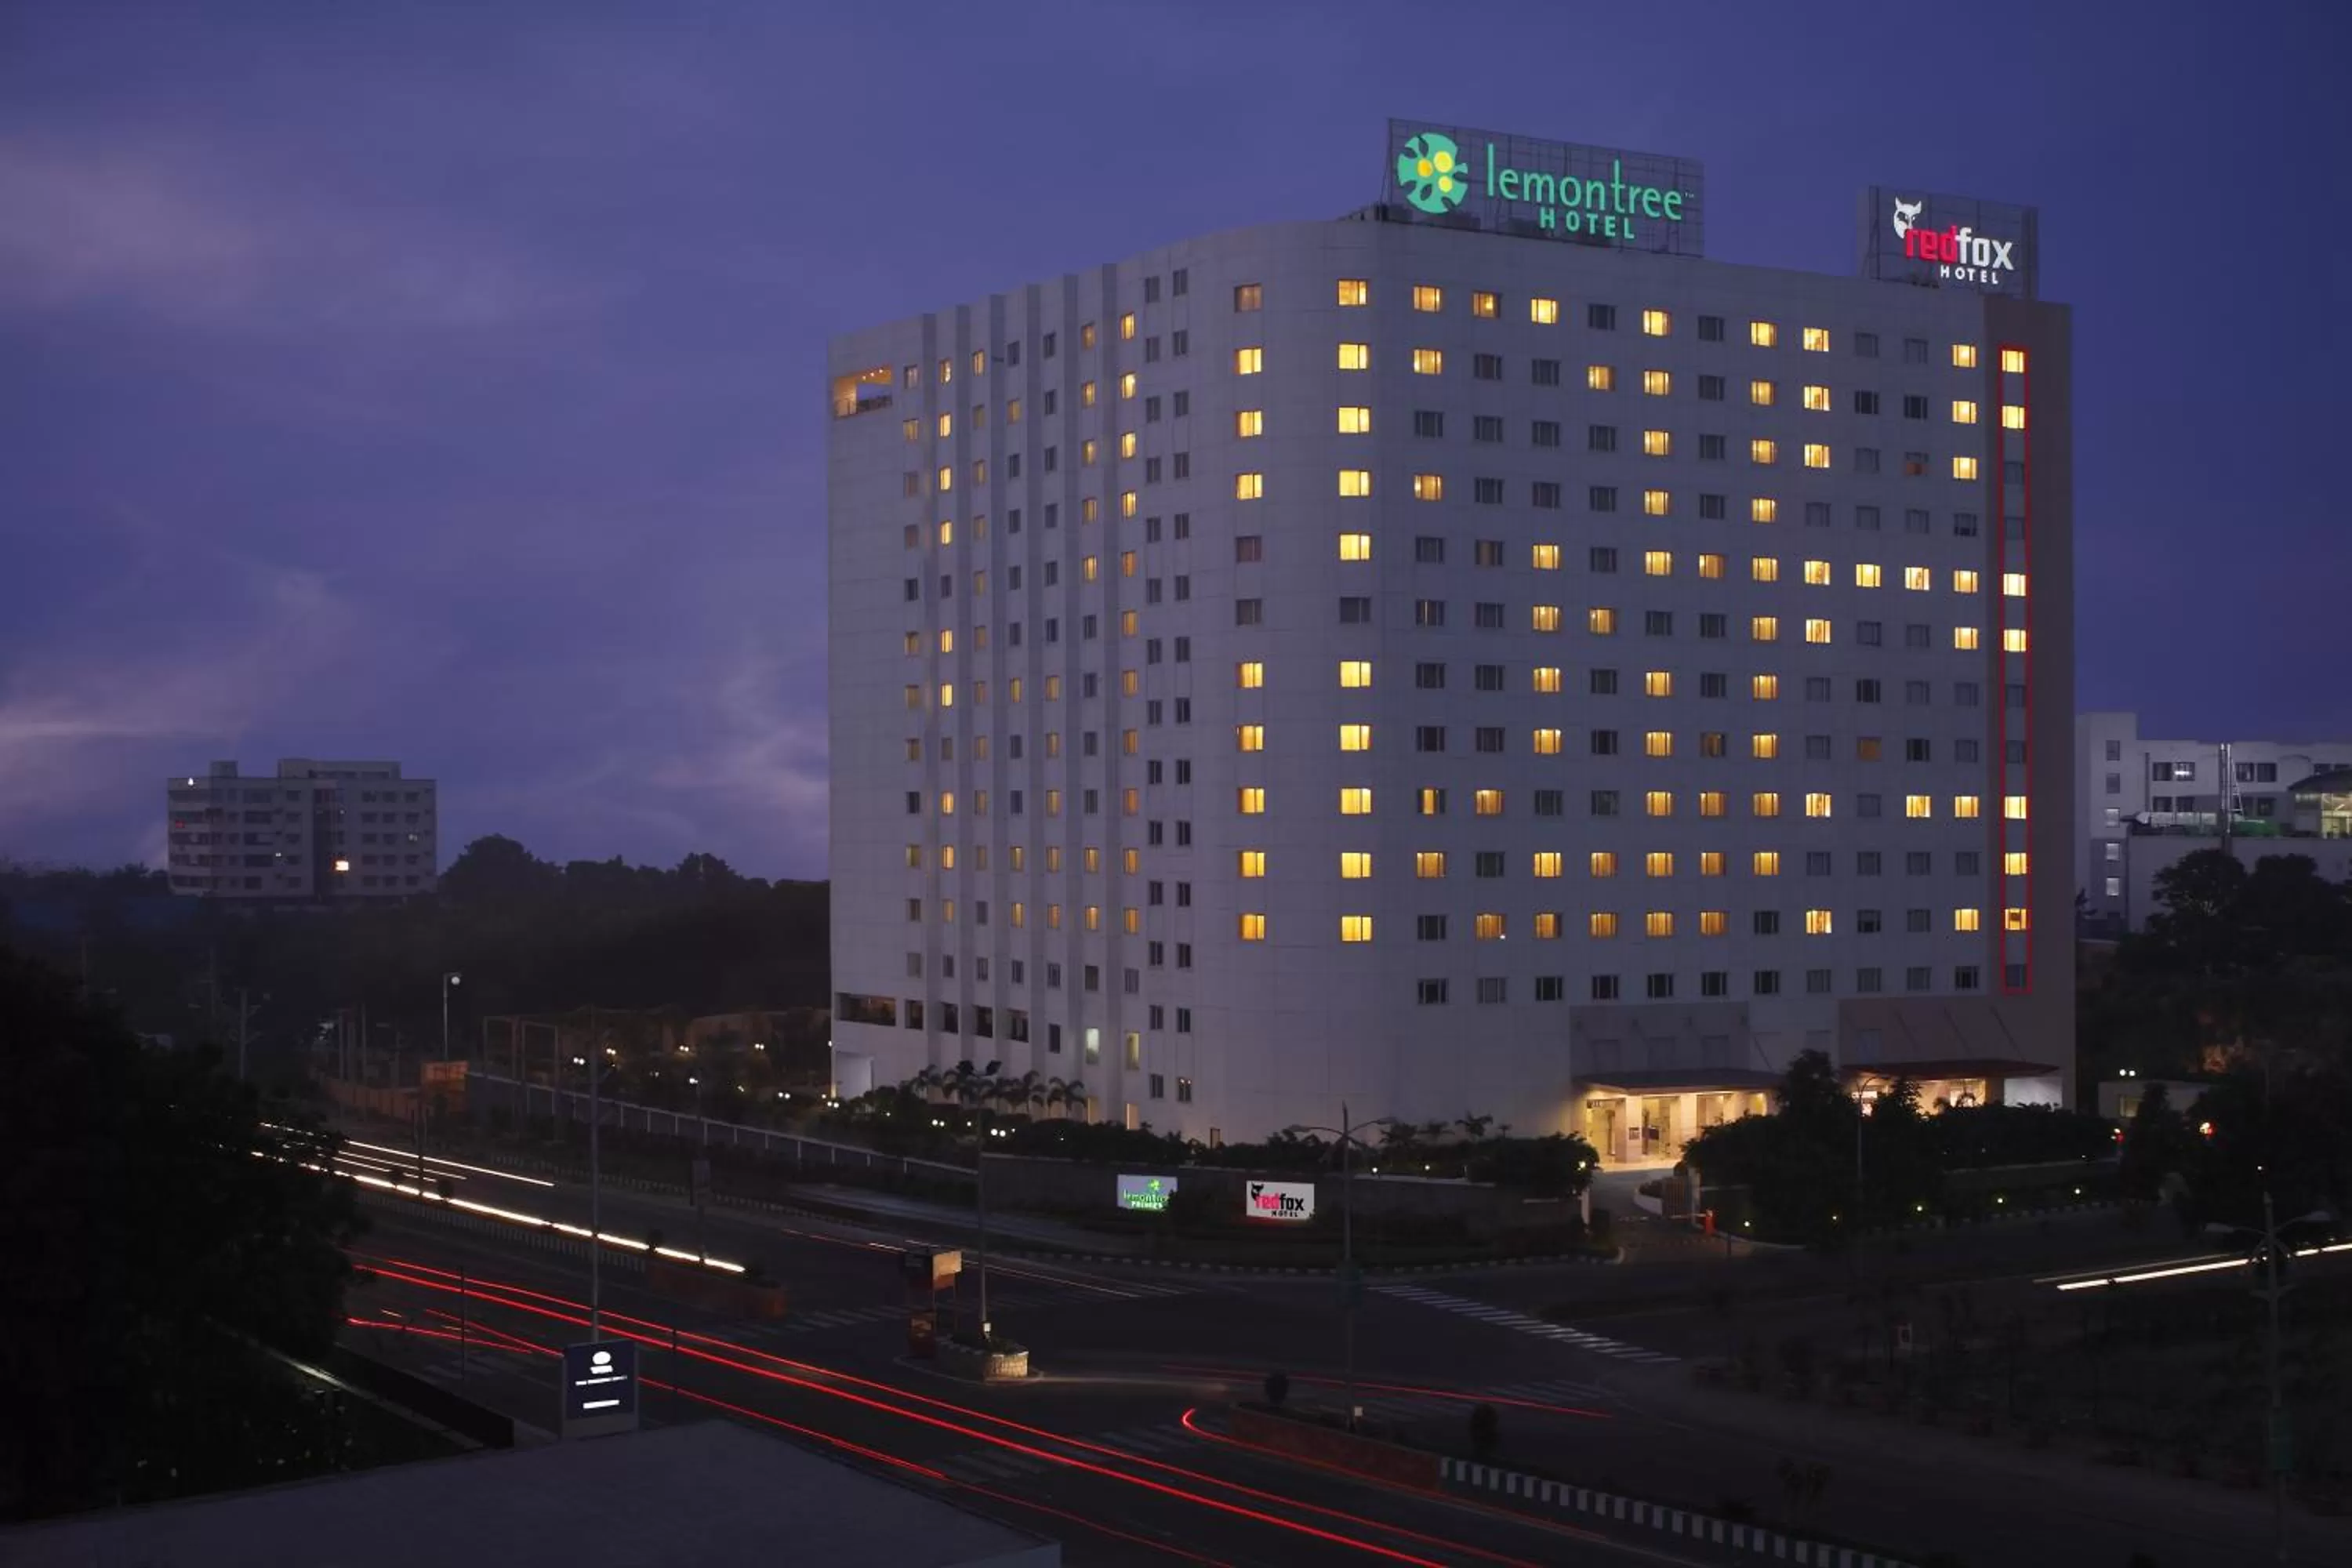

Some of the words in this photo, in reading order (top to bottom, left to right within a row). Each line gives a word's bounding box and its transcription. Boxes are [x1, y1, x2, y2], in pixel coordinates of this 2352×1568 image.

[1486, 143, 1682, 220] lemontree
[1539, 208, 1635, 239] HOTEL
[1904, 223, 2014, 270] redfox
[1940, 265, 1999, 285] HOTEL
[1254, 1192, 1305, 1211] redfox
